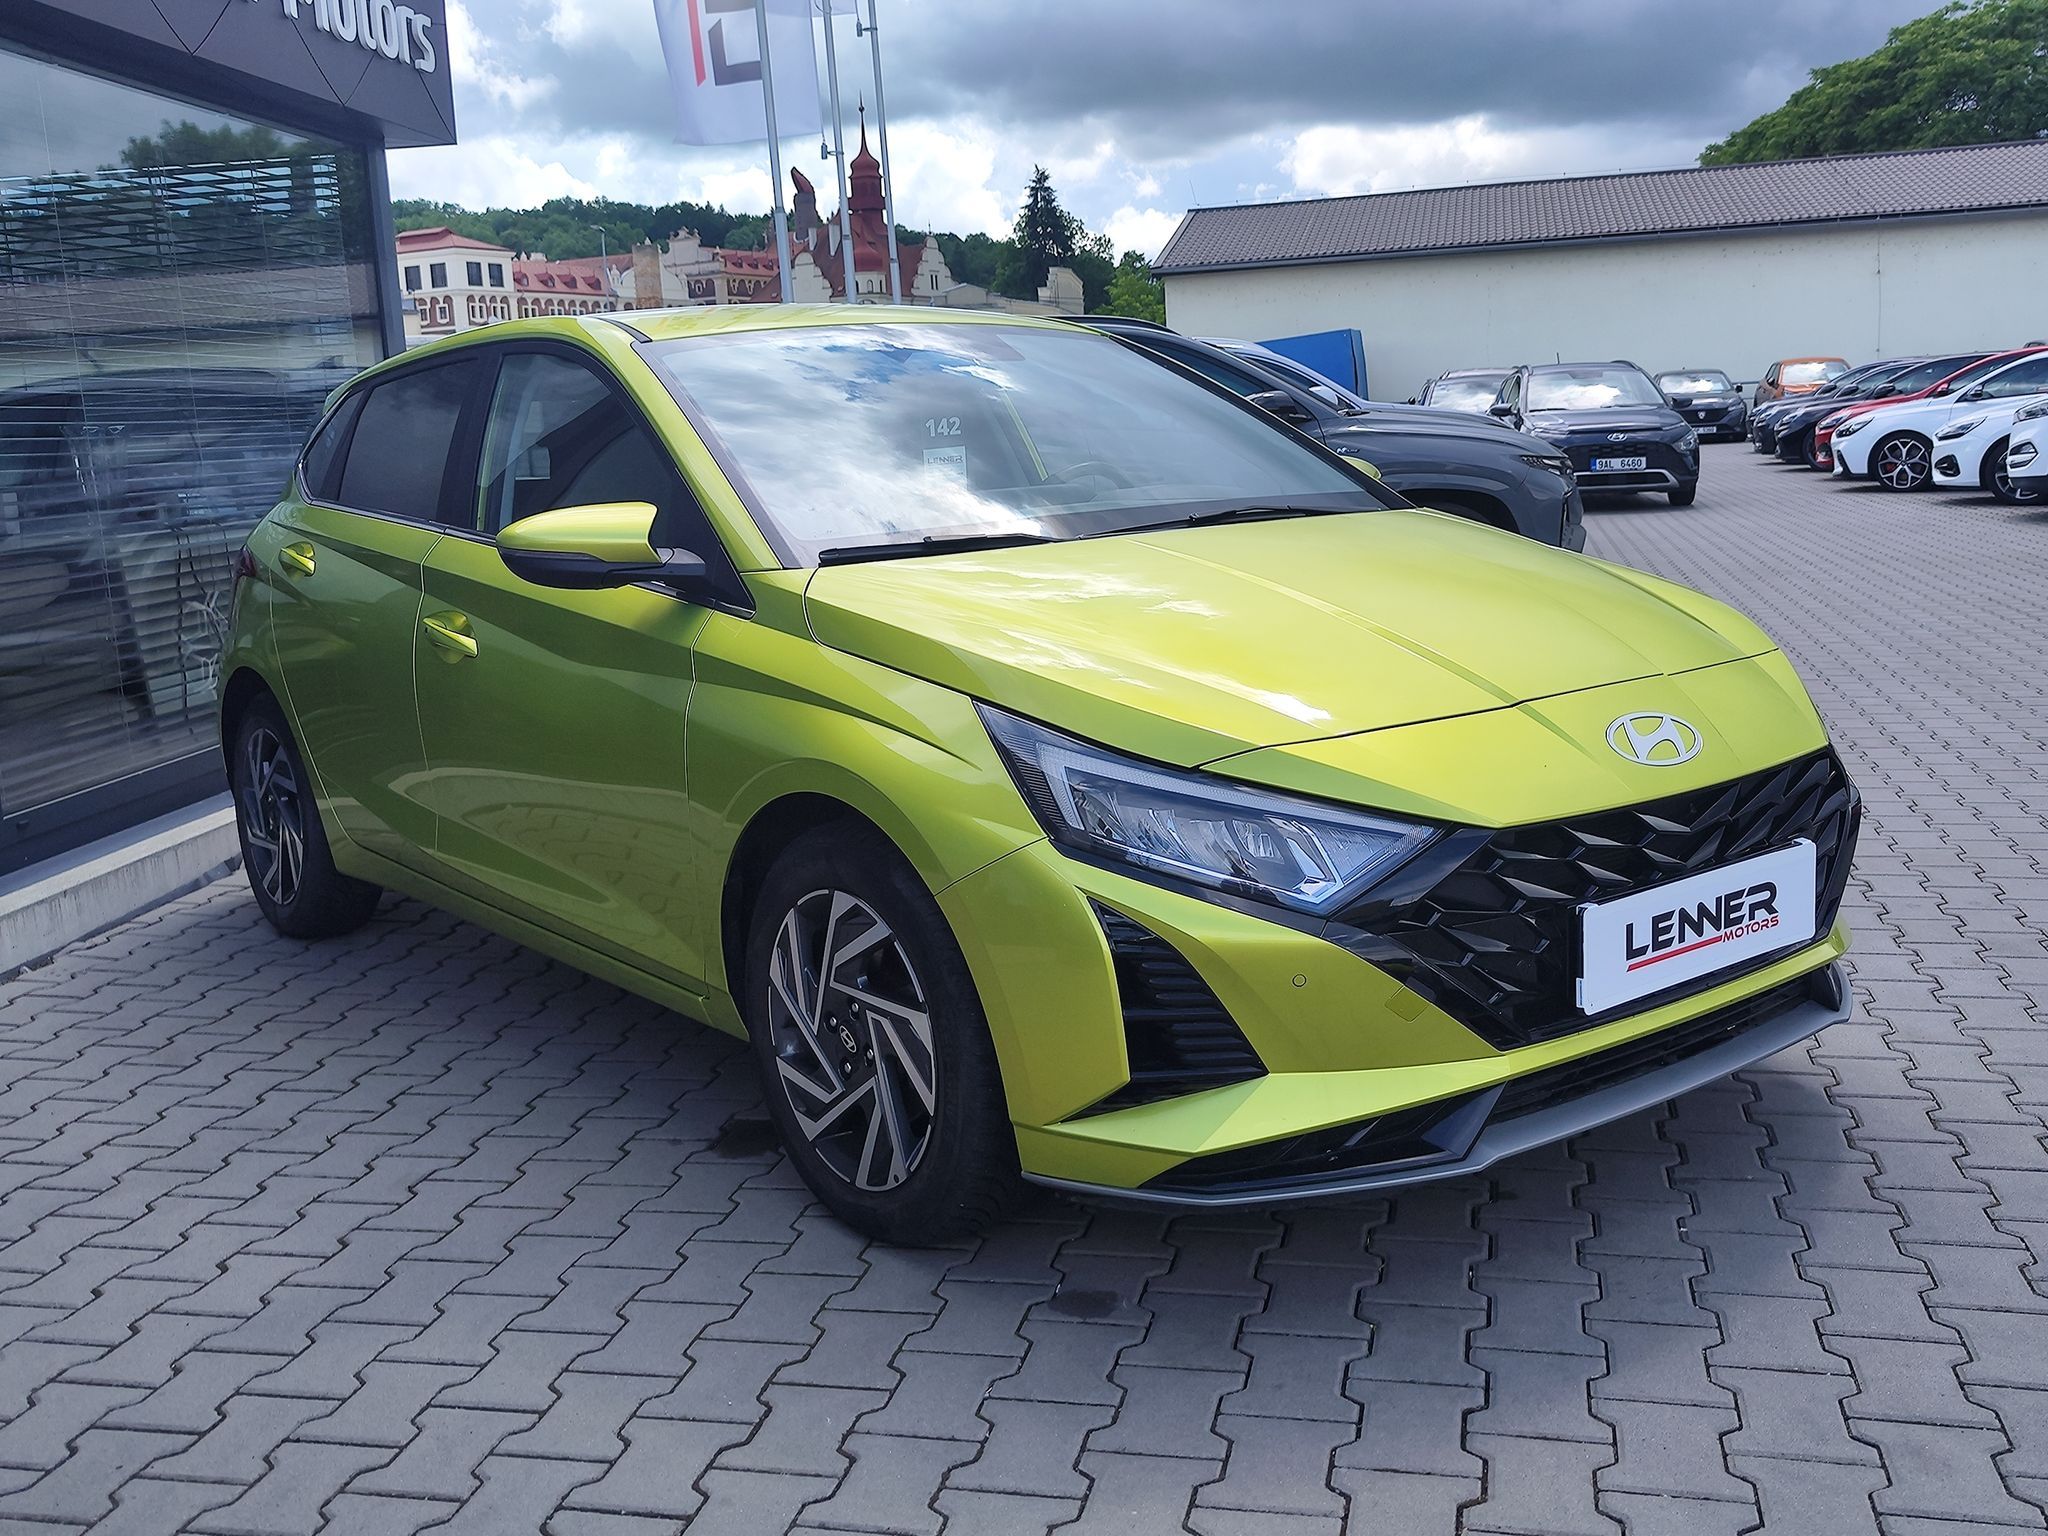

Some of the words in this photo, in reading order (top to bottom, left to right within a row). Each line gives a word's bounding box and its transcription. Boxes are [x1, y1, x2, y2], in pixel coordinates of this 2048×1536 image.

[925, 416, 961, 437] 142
[1598, 459, 1614, 469] 9AL
[1620, 458, 1642, 468] 6460
[1625, 881, 1779, 961] LENNER
[1722, 915, 1780, 943] MOTORS
